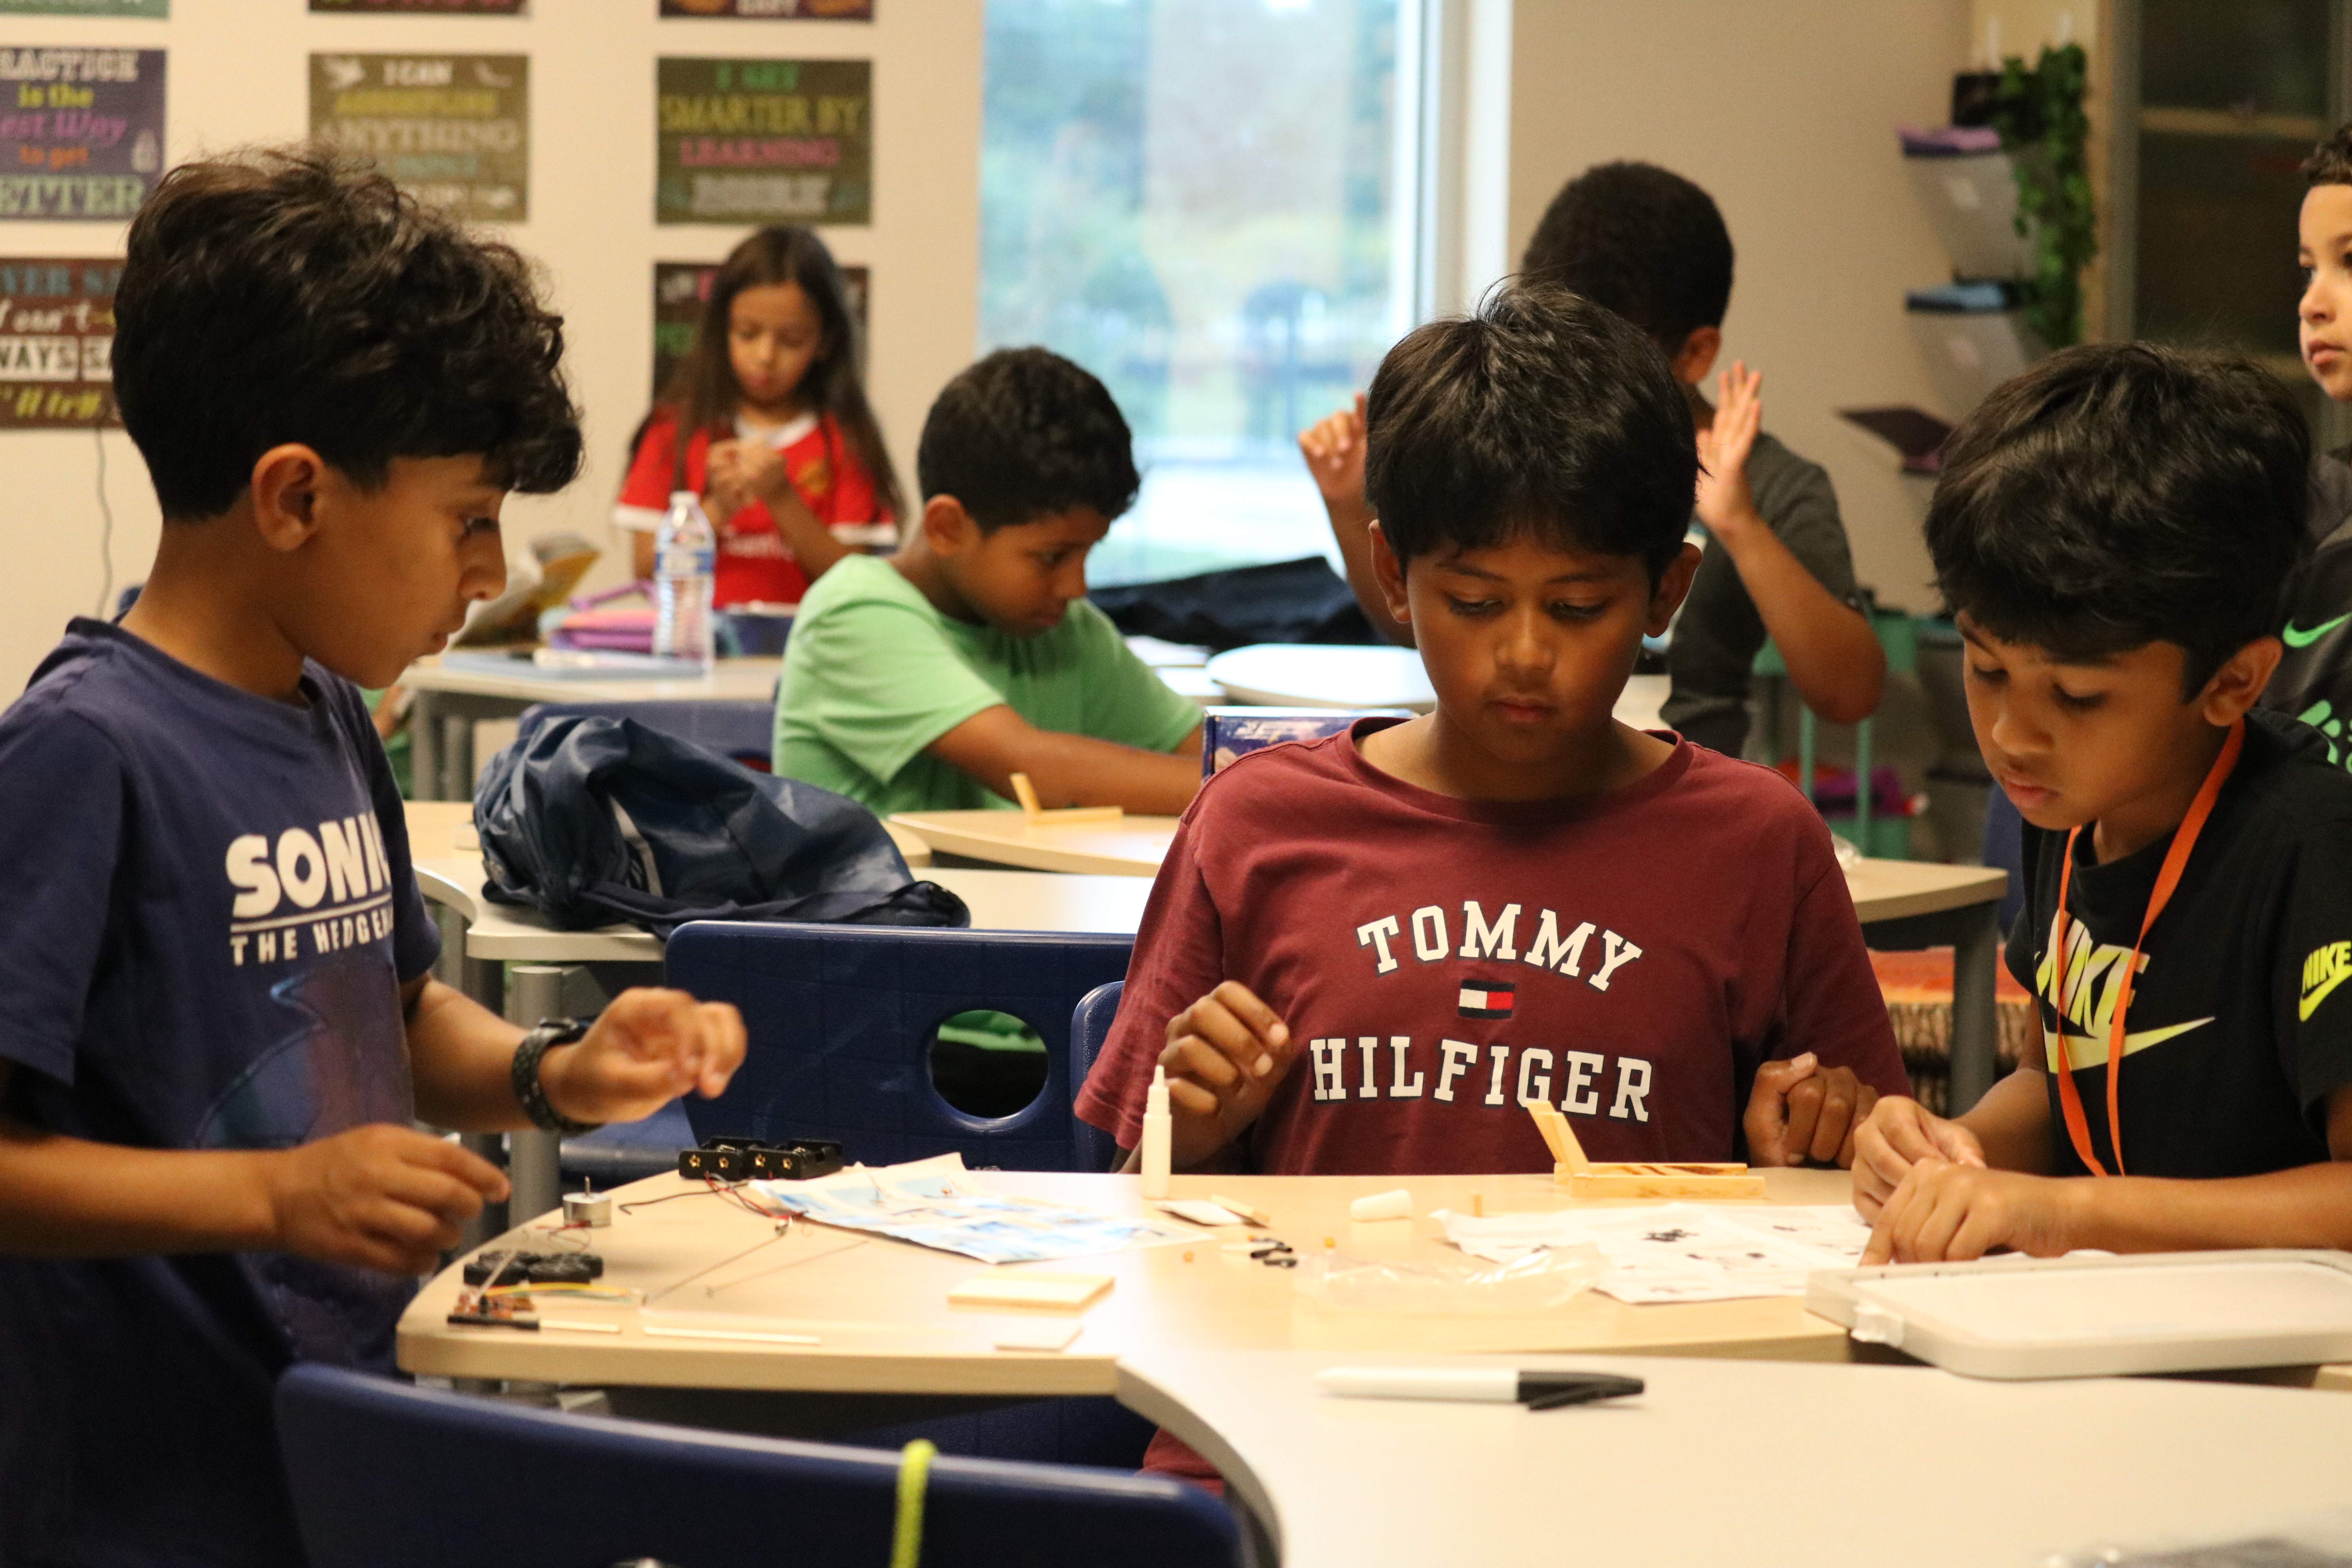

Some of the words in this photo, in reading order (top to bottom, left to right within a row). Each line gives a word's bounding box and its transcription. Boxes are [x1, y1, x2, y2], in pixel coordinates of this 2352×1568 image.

[230, 927, 297, 966] THE
[1356, 900, 1643, 992] TOMMY
[2302, 940, 2352, 994] NIKE
[1309, 1036, 1653, 1123] HILFIGER
